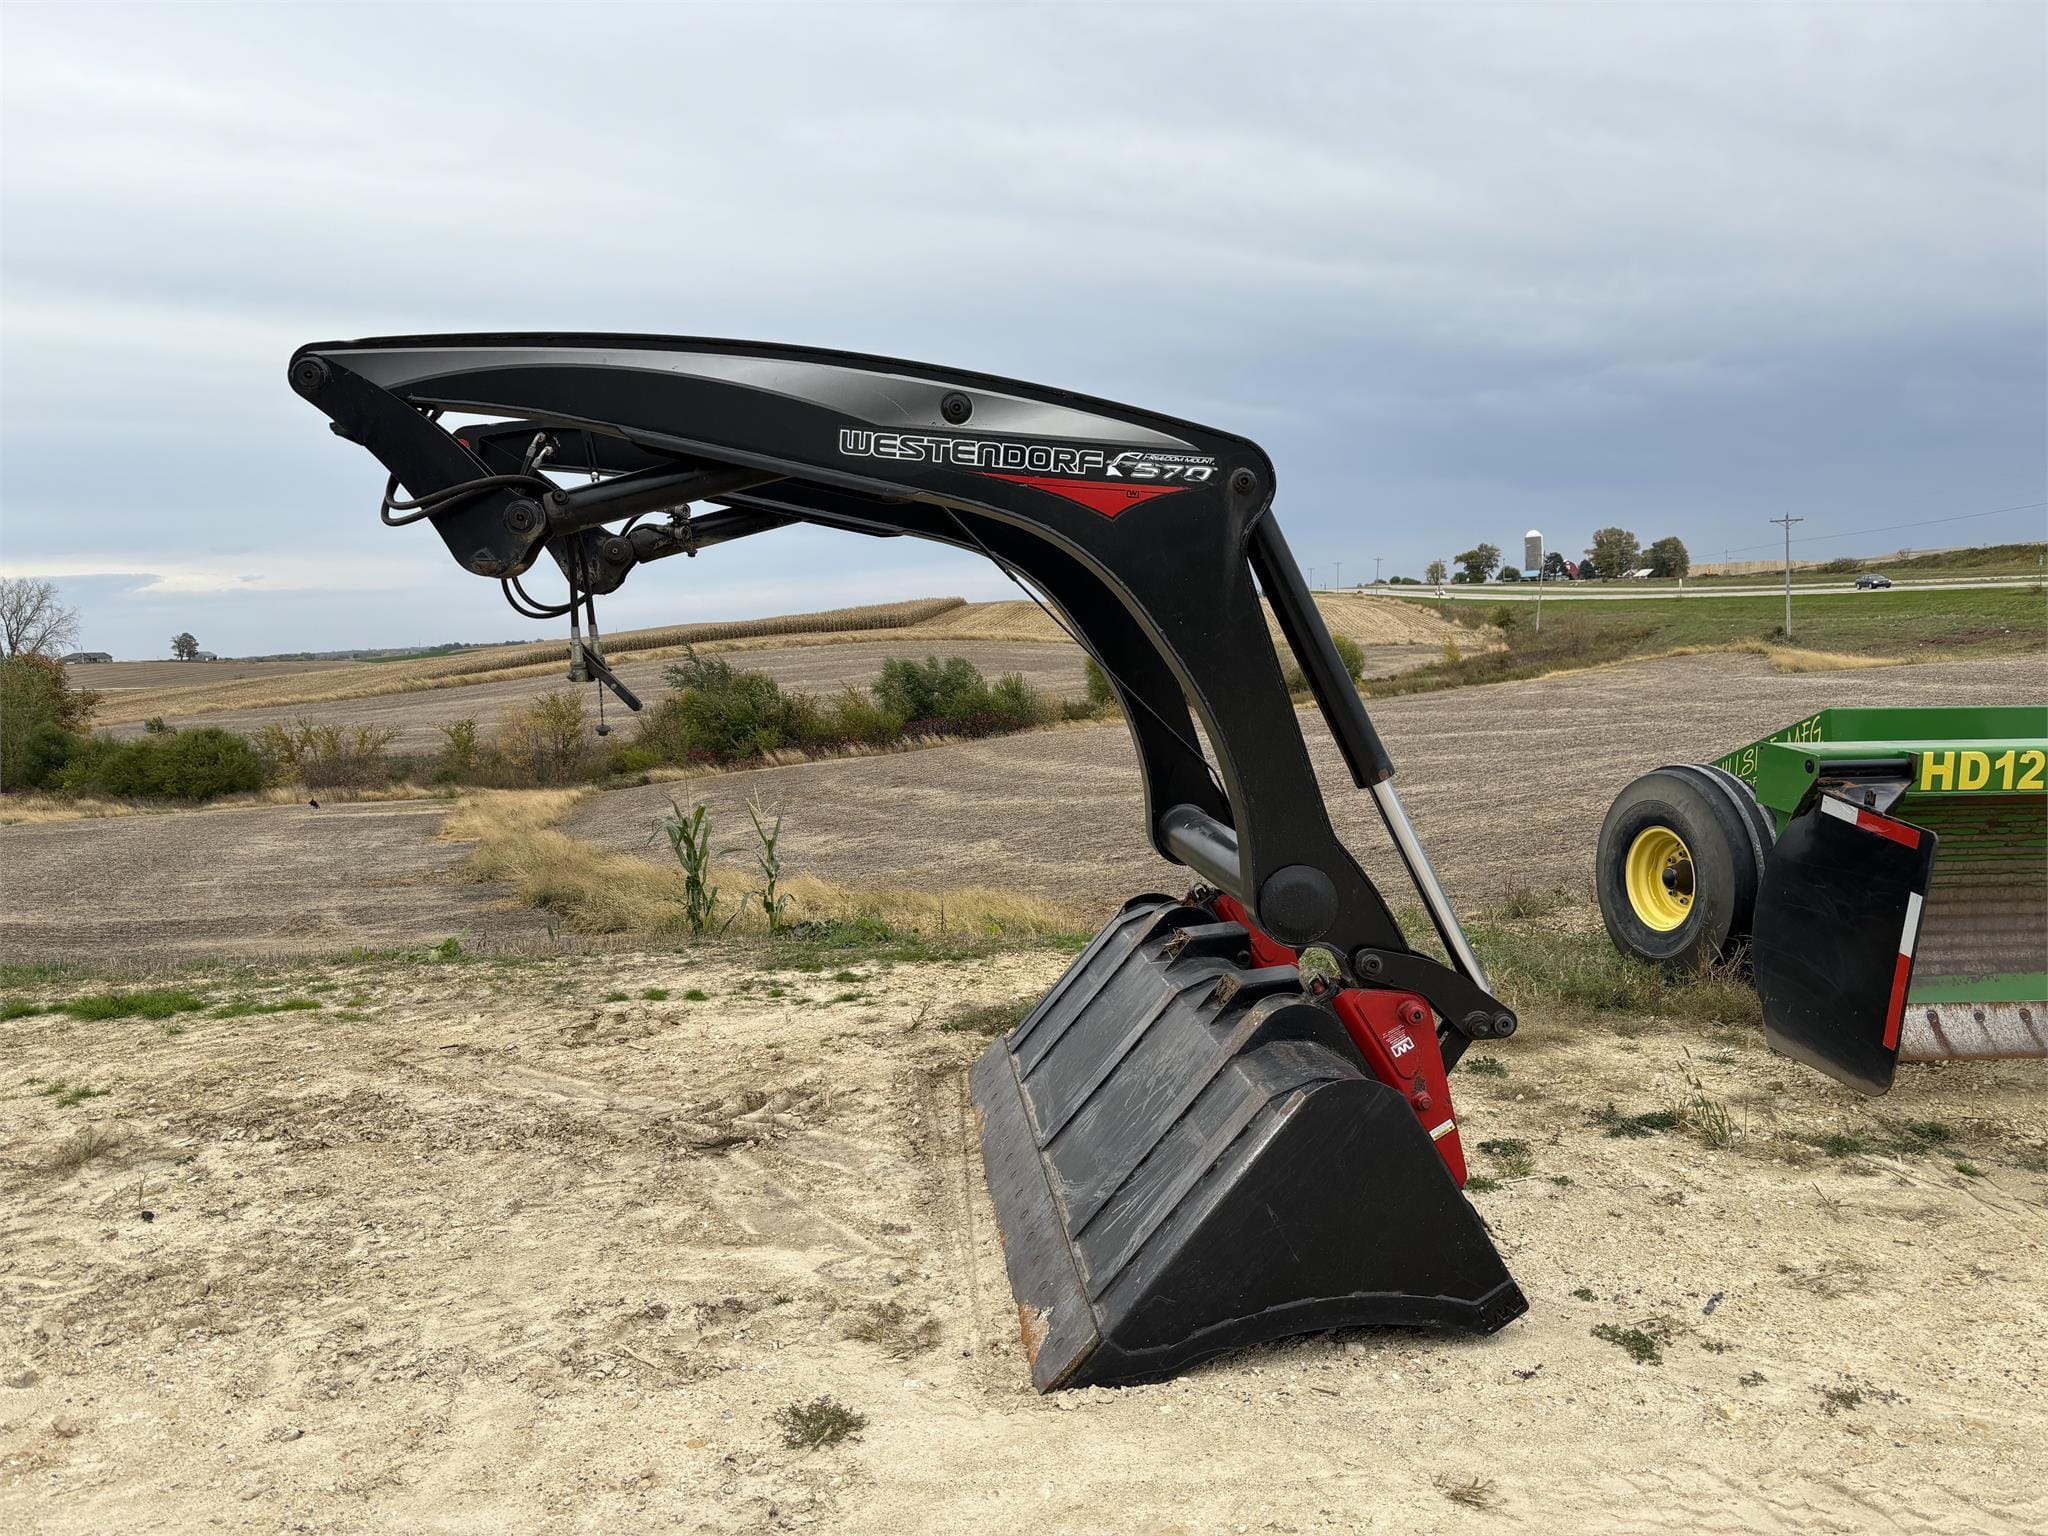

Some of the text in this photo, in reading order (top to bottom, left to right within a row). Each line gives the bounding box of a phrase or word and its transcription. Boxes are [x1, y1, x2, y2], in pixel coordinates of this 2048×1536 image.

[839, 429, 1104, 474] WESTENDORF
[1143, 453, 1184, 463] FREEDOM
[1920, 750, 2046, 790] HD12
